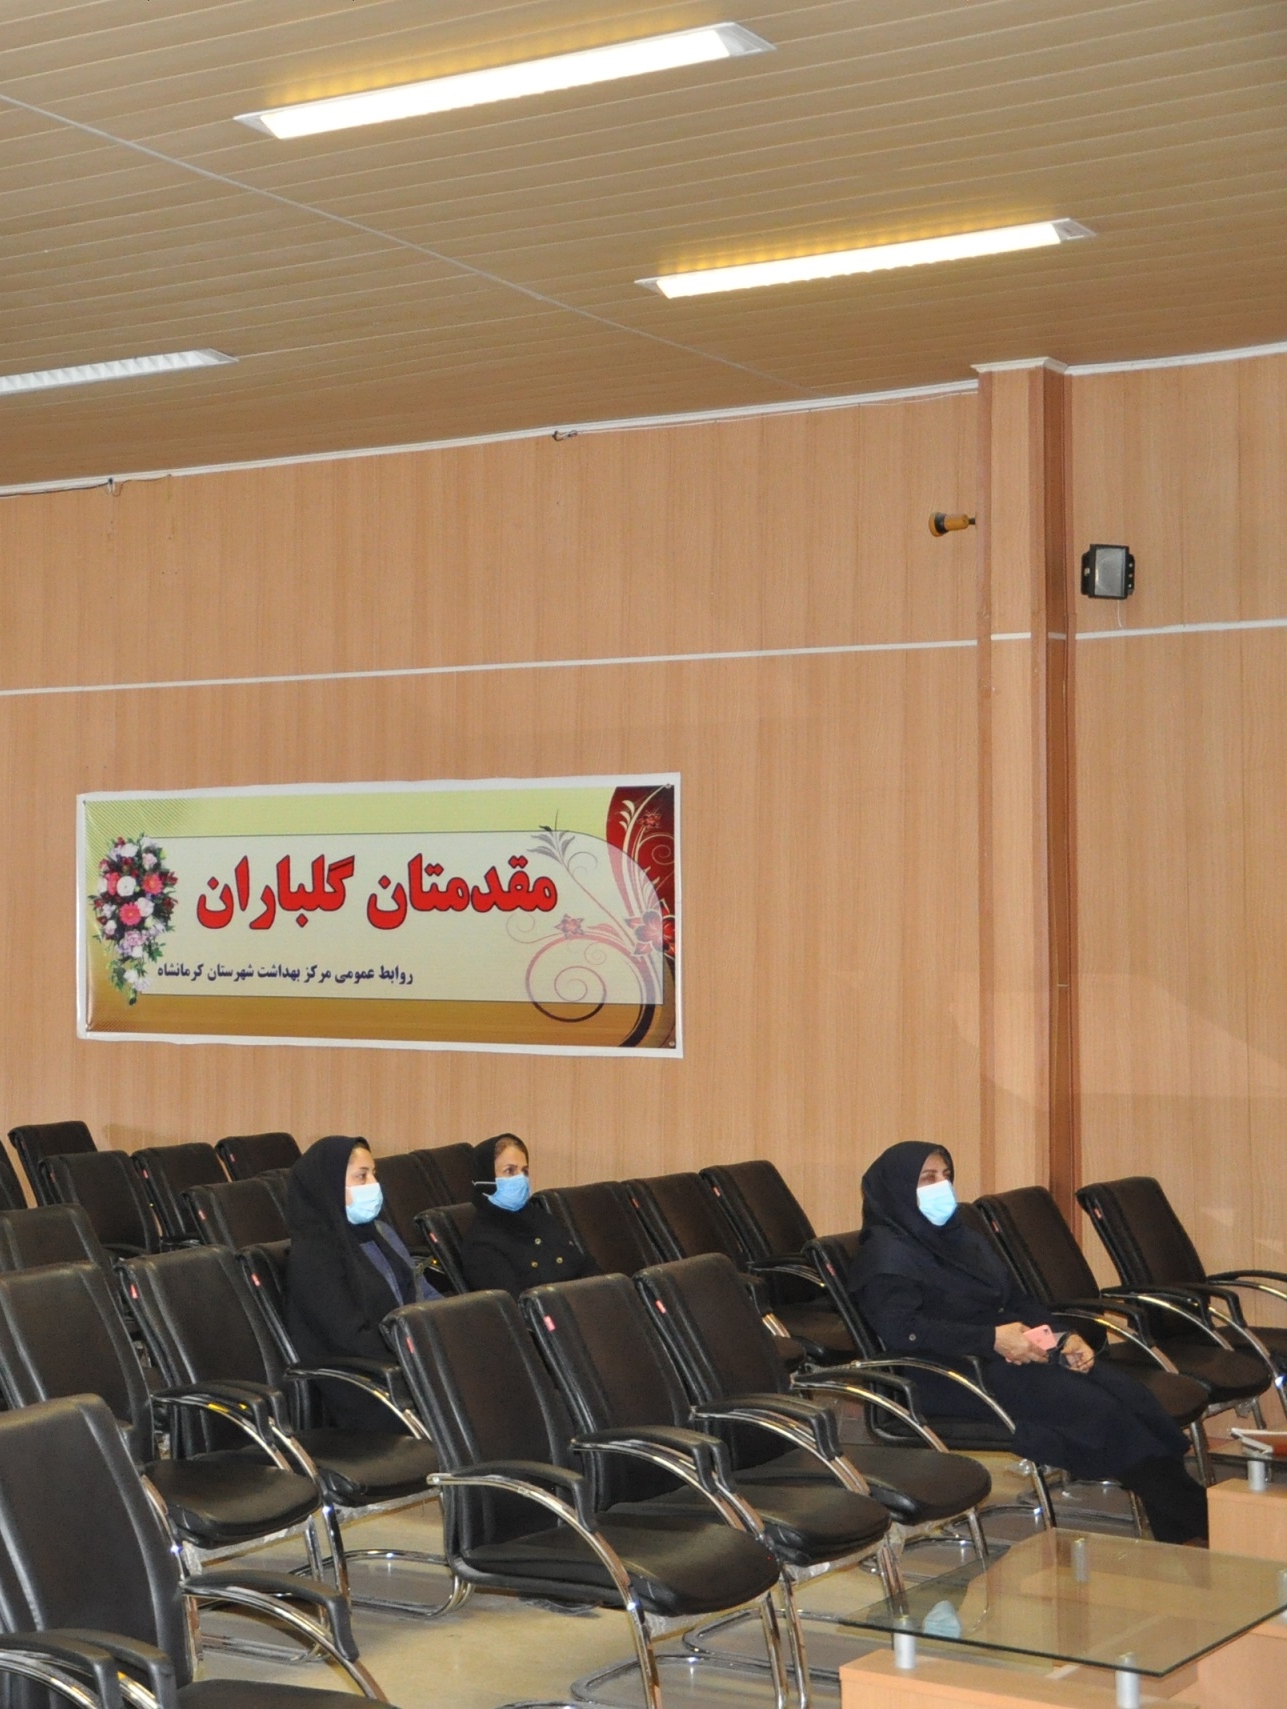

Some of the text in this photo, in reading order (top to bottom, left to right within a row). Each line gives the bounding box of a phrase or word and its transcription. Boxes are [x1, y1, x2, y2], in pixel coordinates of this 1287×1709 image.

[196, 852, 559, 931] مقدمتان گلباران
[156, 963, 414, 985] روابط عمومی مرکز بهداشت شهرستان کرمانشاه
